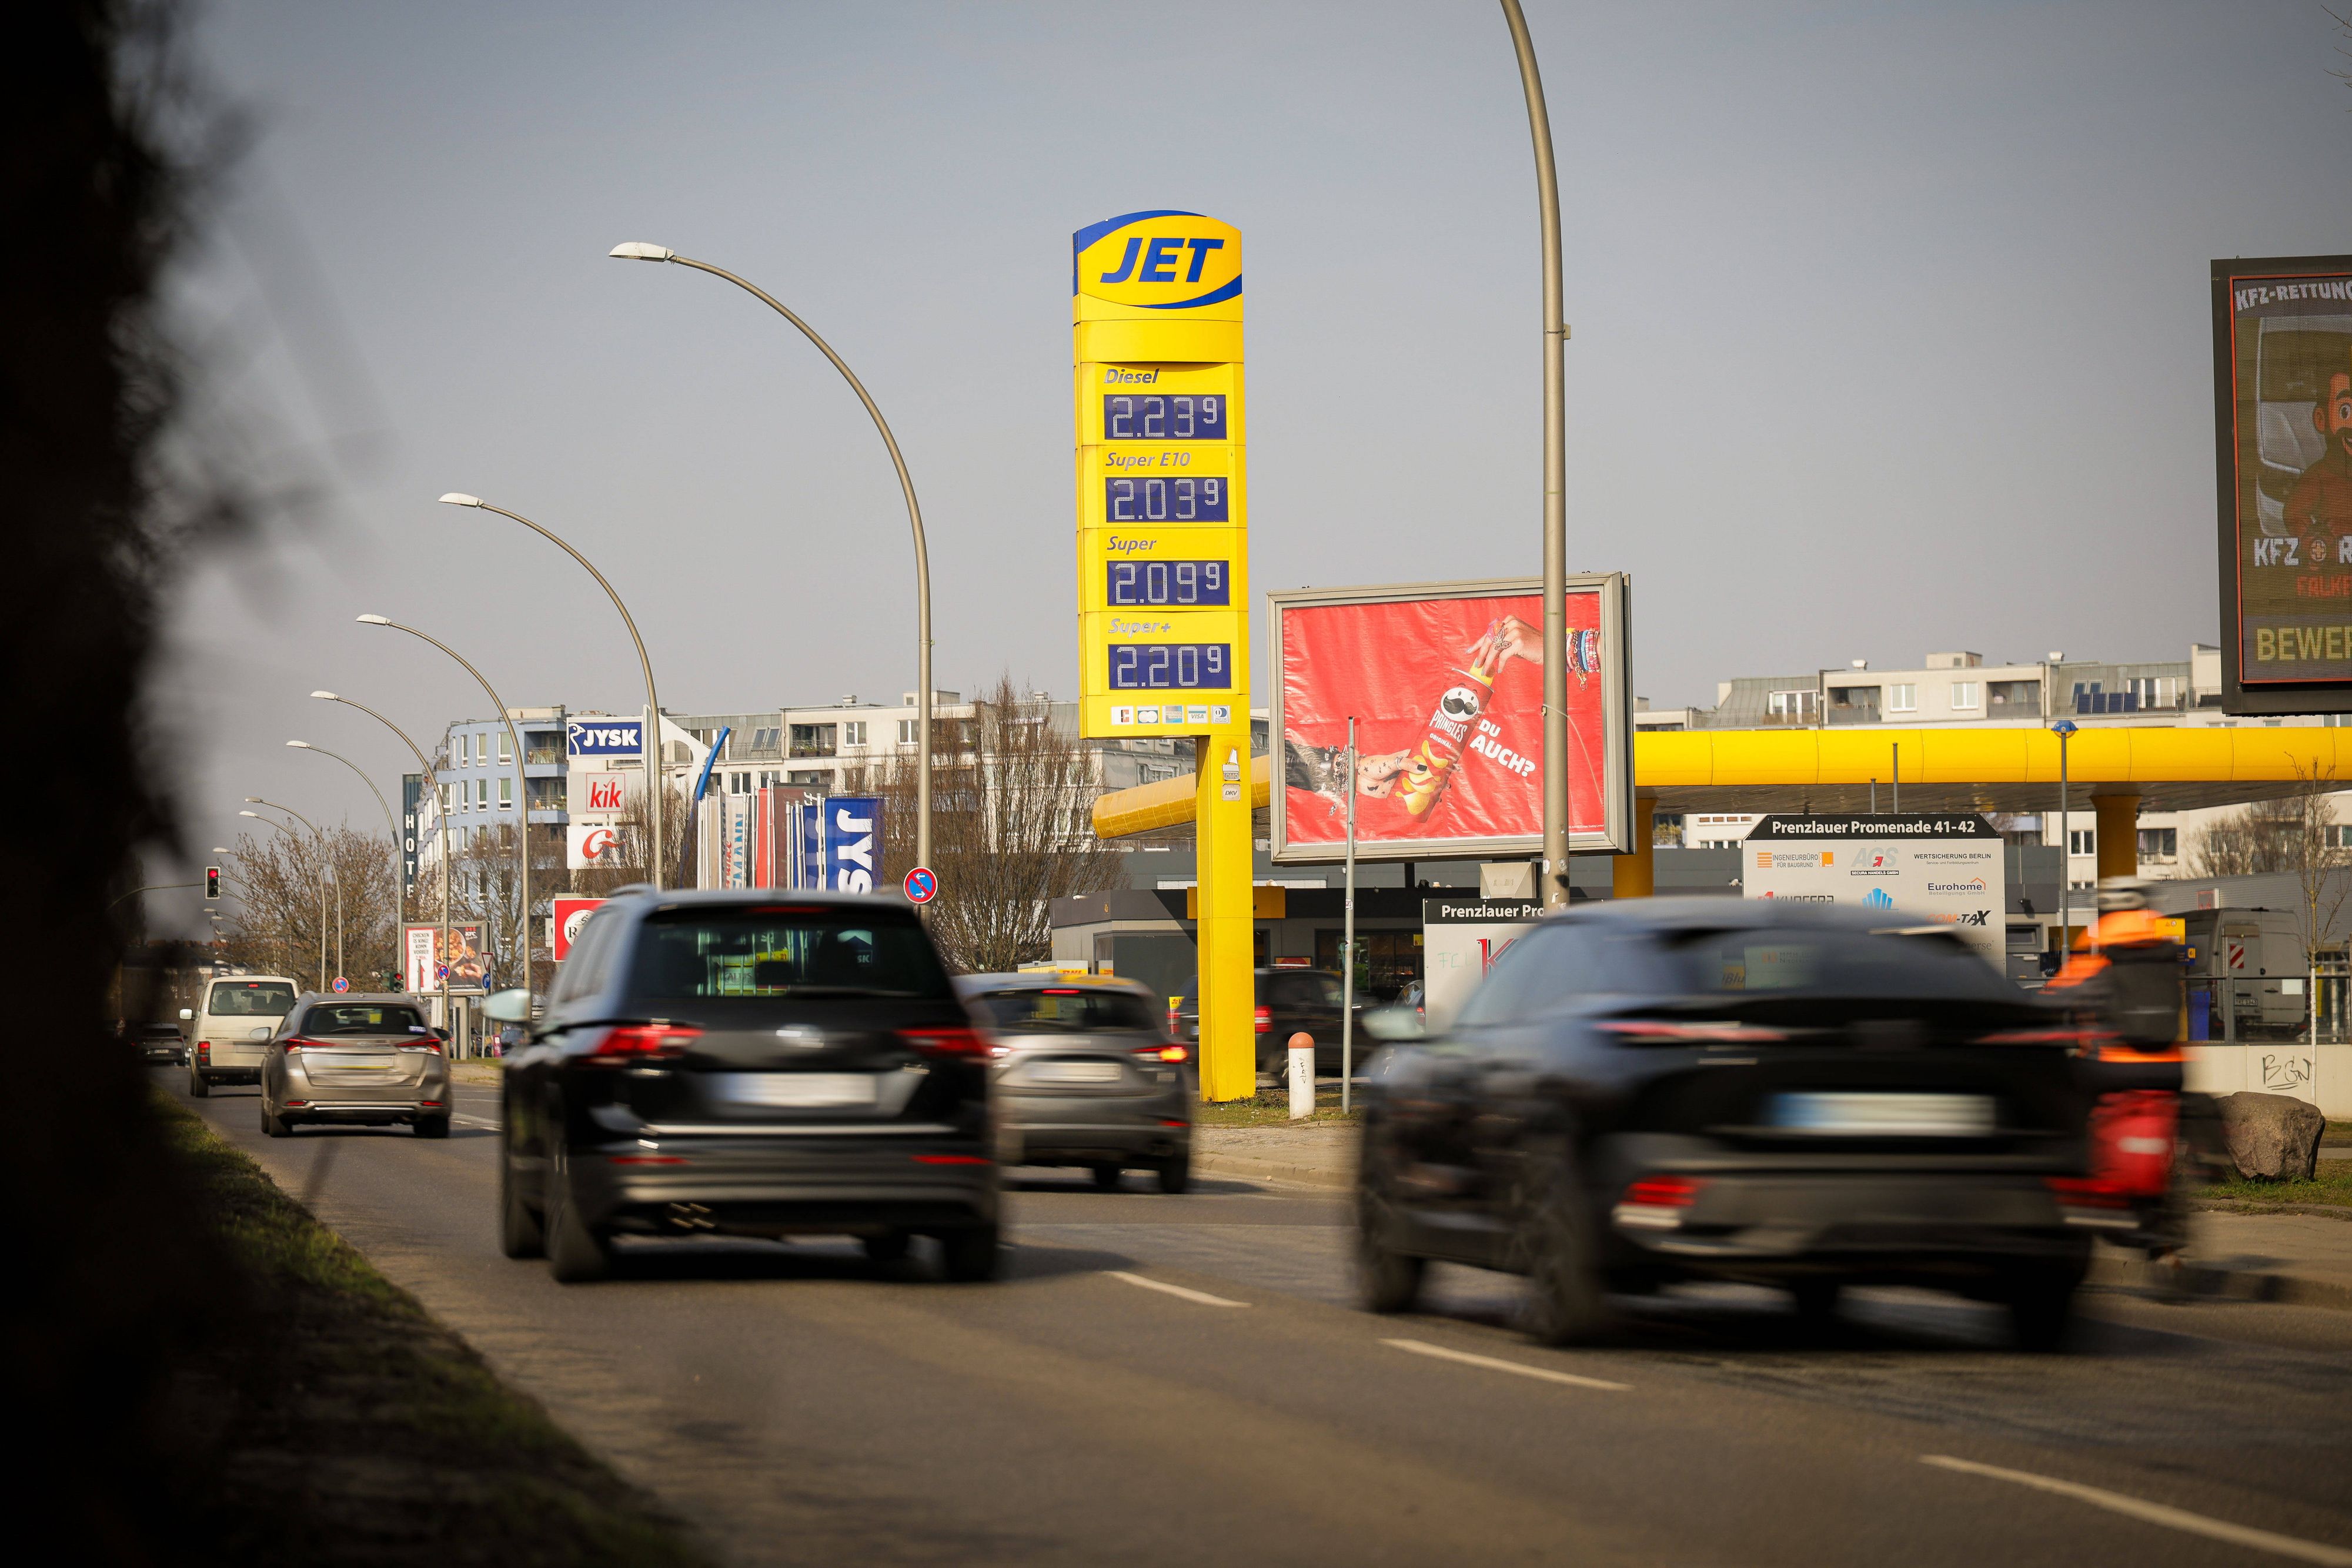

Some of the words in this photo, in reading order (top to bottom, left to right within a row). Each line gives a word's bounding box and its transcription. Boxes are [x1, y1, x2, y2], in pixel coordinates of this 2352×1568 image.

[1100, 238, 1224, 283] JET
[1103, 369, 1160, 384] Diesel
[1105, 452, 1155, 470] Super
[1160, 452, 1191, 466] E10
[1107, 536, 1157, 554] Super
[2253, 537, 2299, 567] KFZ
[1429, 709, 1468, 743] PRINGLES
[1478, 718, 1501, 738] DU
[583, 728, 639, 747] JYSK
[1429, 733, 1453, 748] ORIGINAL
[1469, 734, 1536, 777] AUCH?
[590, 778, 622, 808] kik
[1772, 821, 1848, 834] Prenzlauer
[1851, 820, 1931, 834] Promenade
[1934, 820, 1976, 833] 41-42
[1772, 853, 1818, 861] INGENIEURBÜRO
[1851, 847, 1899, 867] AGS
[1442, 905, 1519, 918] Prenzlauer
[1926, 910, 1992, 926] COM-TAX
